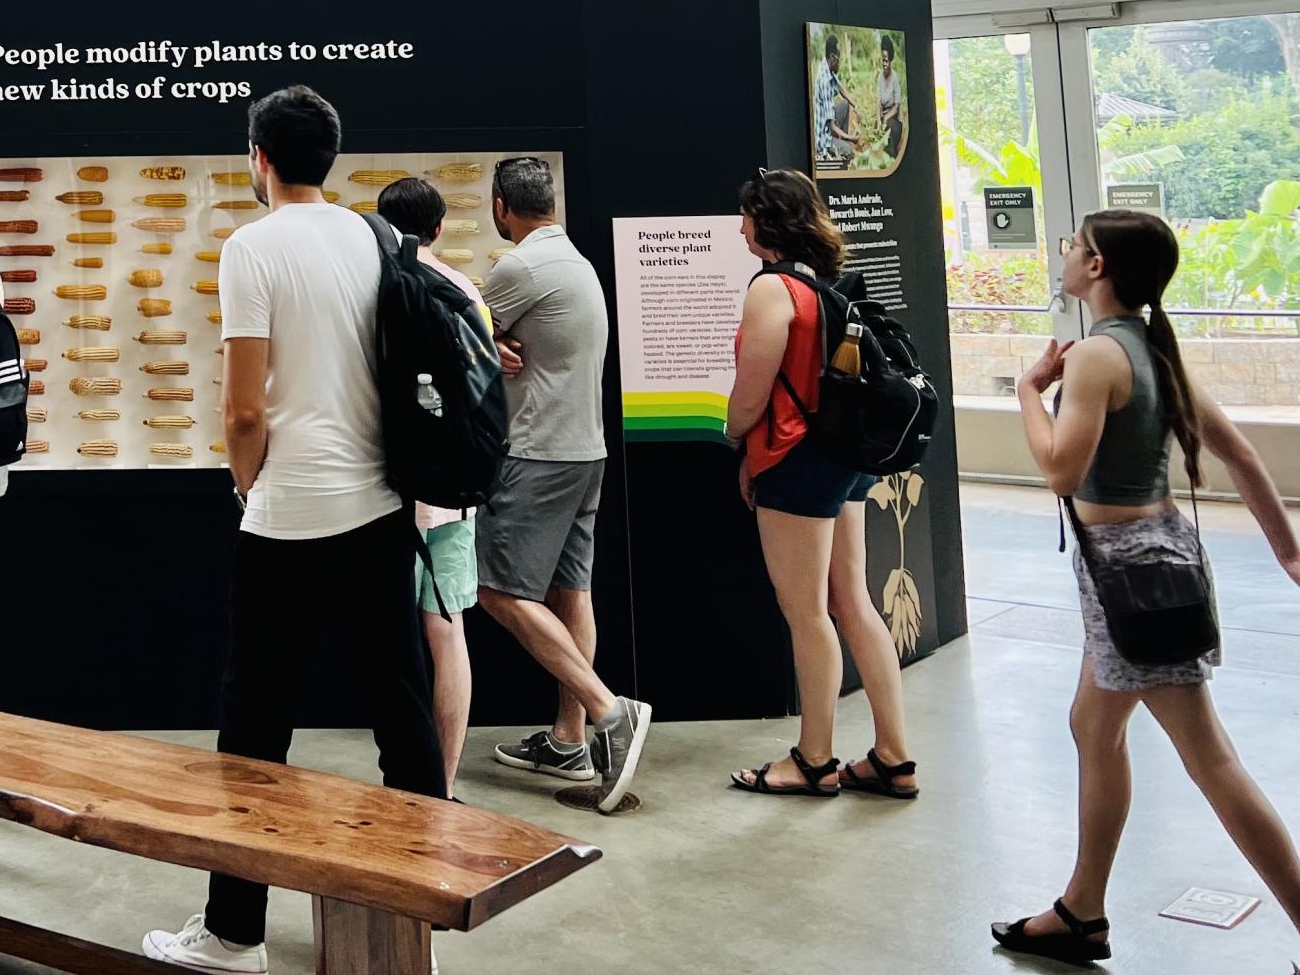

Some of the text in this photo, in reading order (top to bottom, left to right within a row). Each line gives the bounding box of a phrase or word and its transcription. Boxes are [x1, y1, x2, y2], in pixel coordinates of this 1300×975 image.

[86, 41, 188, 67] modify
[194, 41, 282, 67] plants
[288, 42, 316, 60] to
[323, 40, 413, 59] create
[51, 78, 129, 99] kinds
[135, 77, 166, 98] of
[171, 82, 251, 103] crops
[829, 194, 883, 205] Drs. Maria Andrade,
[829, 208, 853, 219] Howarth
[871, 207, 880, 216] Jan
[842, 222, 860, 232] Robert
[638, 230, 711, 241] People breed
[639, 244, 711, 254] diverse plant
[640, 257, 689, 266] varieties
